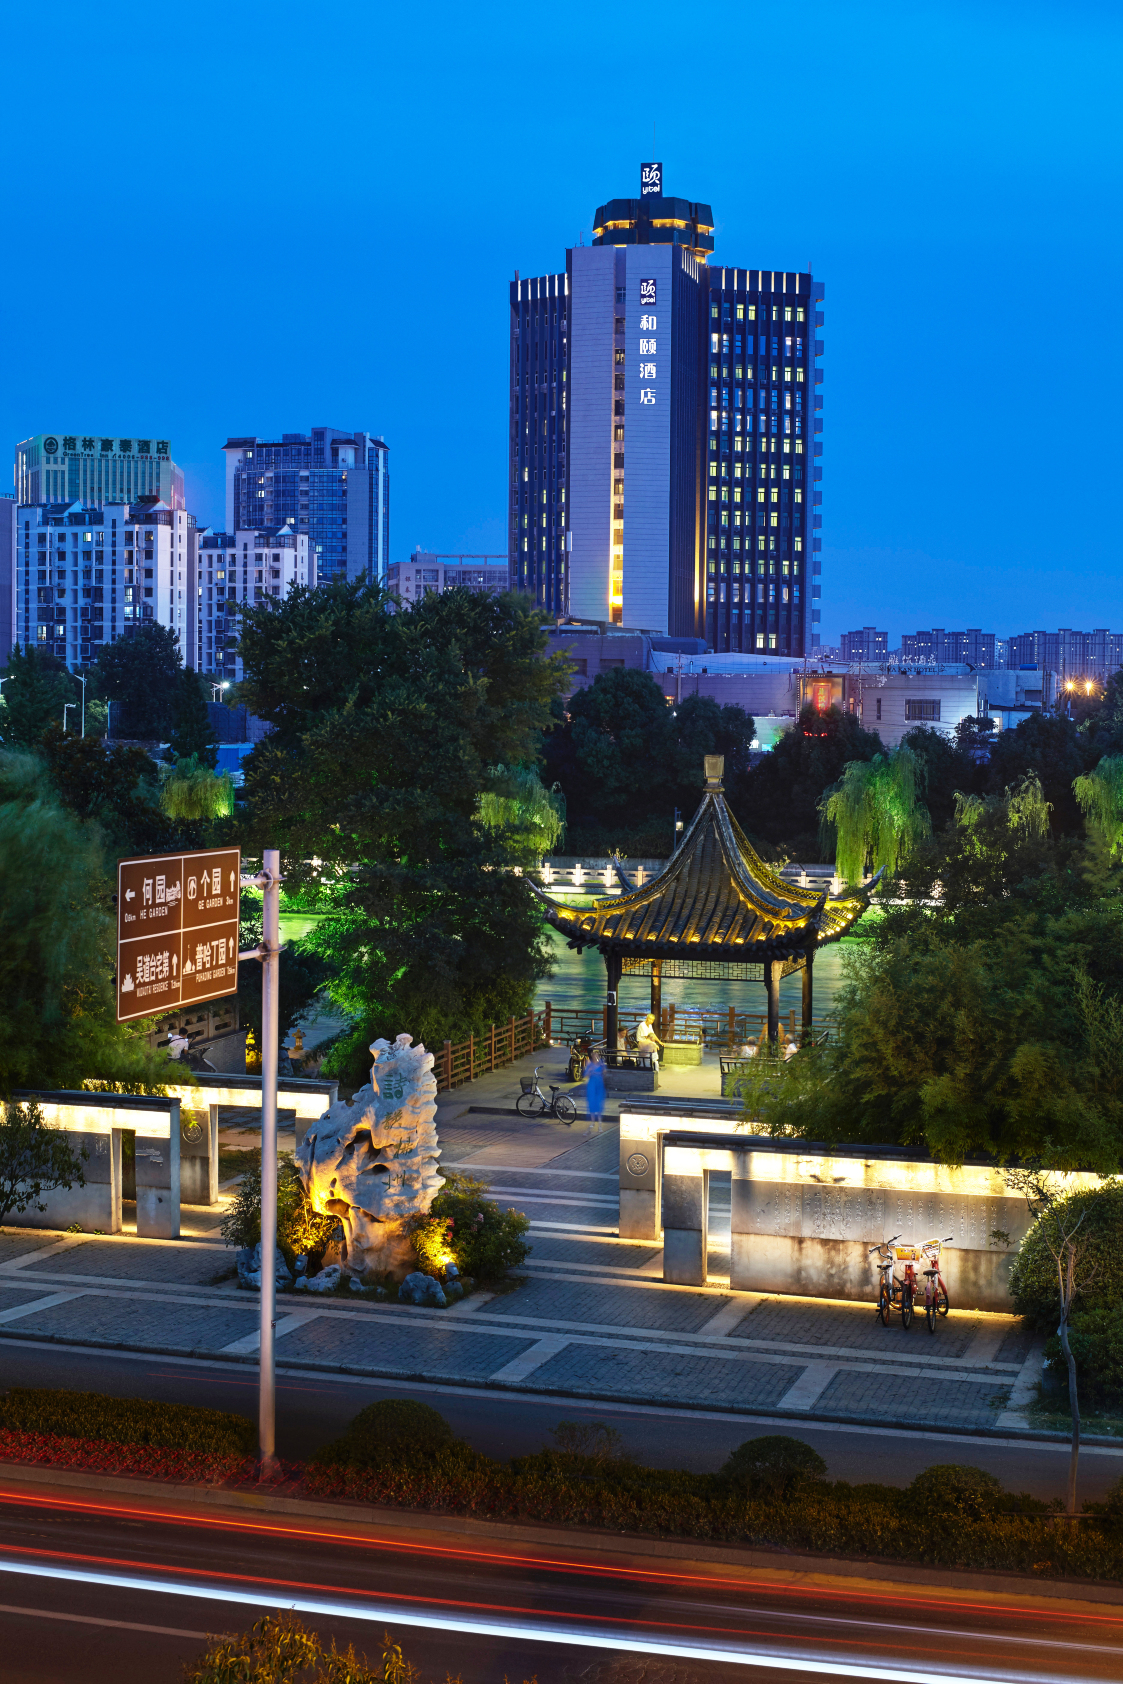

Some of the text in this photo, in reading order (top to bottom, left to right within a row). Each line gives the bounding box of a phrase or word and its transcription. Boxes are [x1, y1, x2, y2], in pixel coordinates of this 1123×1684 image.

[642, 184, 661, 195] yitel
[640, 296, 656, 305] yitel
[639, 314, 657, 405] 和颐酒店
[62, 436, 169, 455] 格林豪泰酒店
[143, 875, 165, 905] 何园
[201, 868, 221, 896] 个园
[140, 909, 146, 919] HE
[149, 906, 168, 918] GARDEN
[199, 900, 204, 909] GE
[207, 897, 223, 908] GARDEN
[196, 938, 226, 970] 普哈丁园
[136, 950, 169, 984] 吴道台宅第
[213, 968, 225, 978] GARDEN
